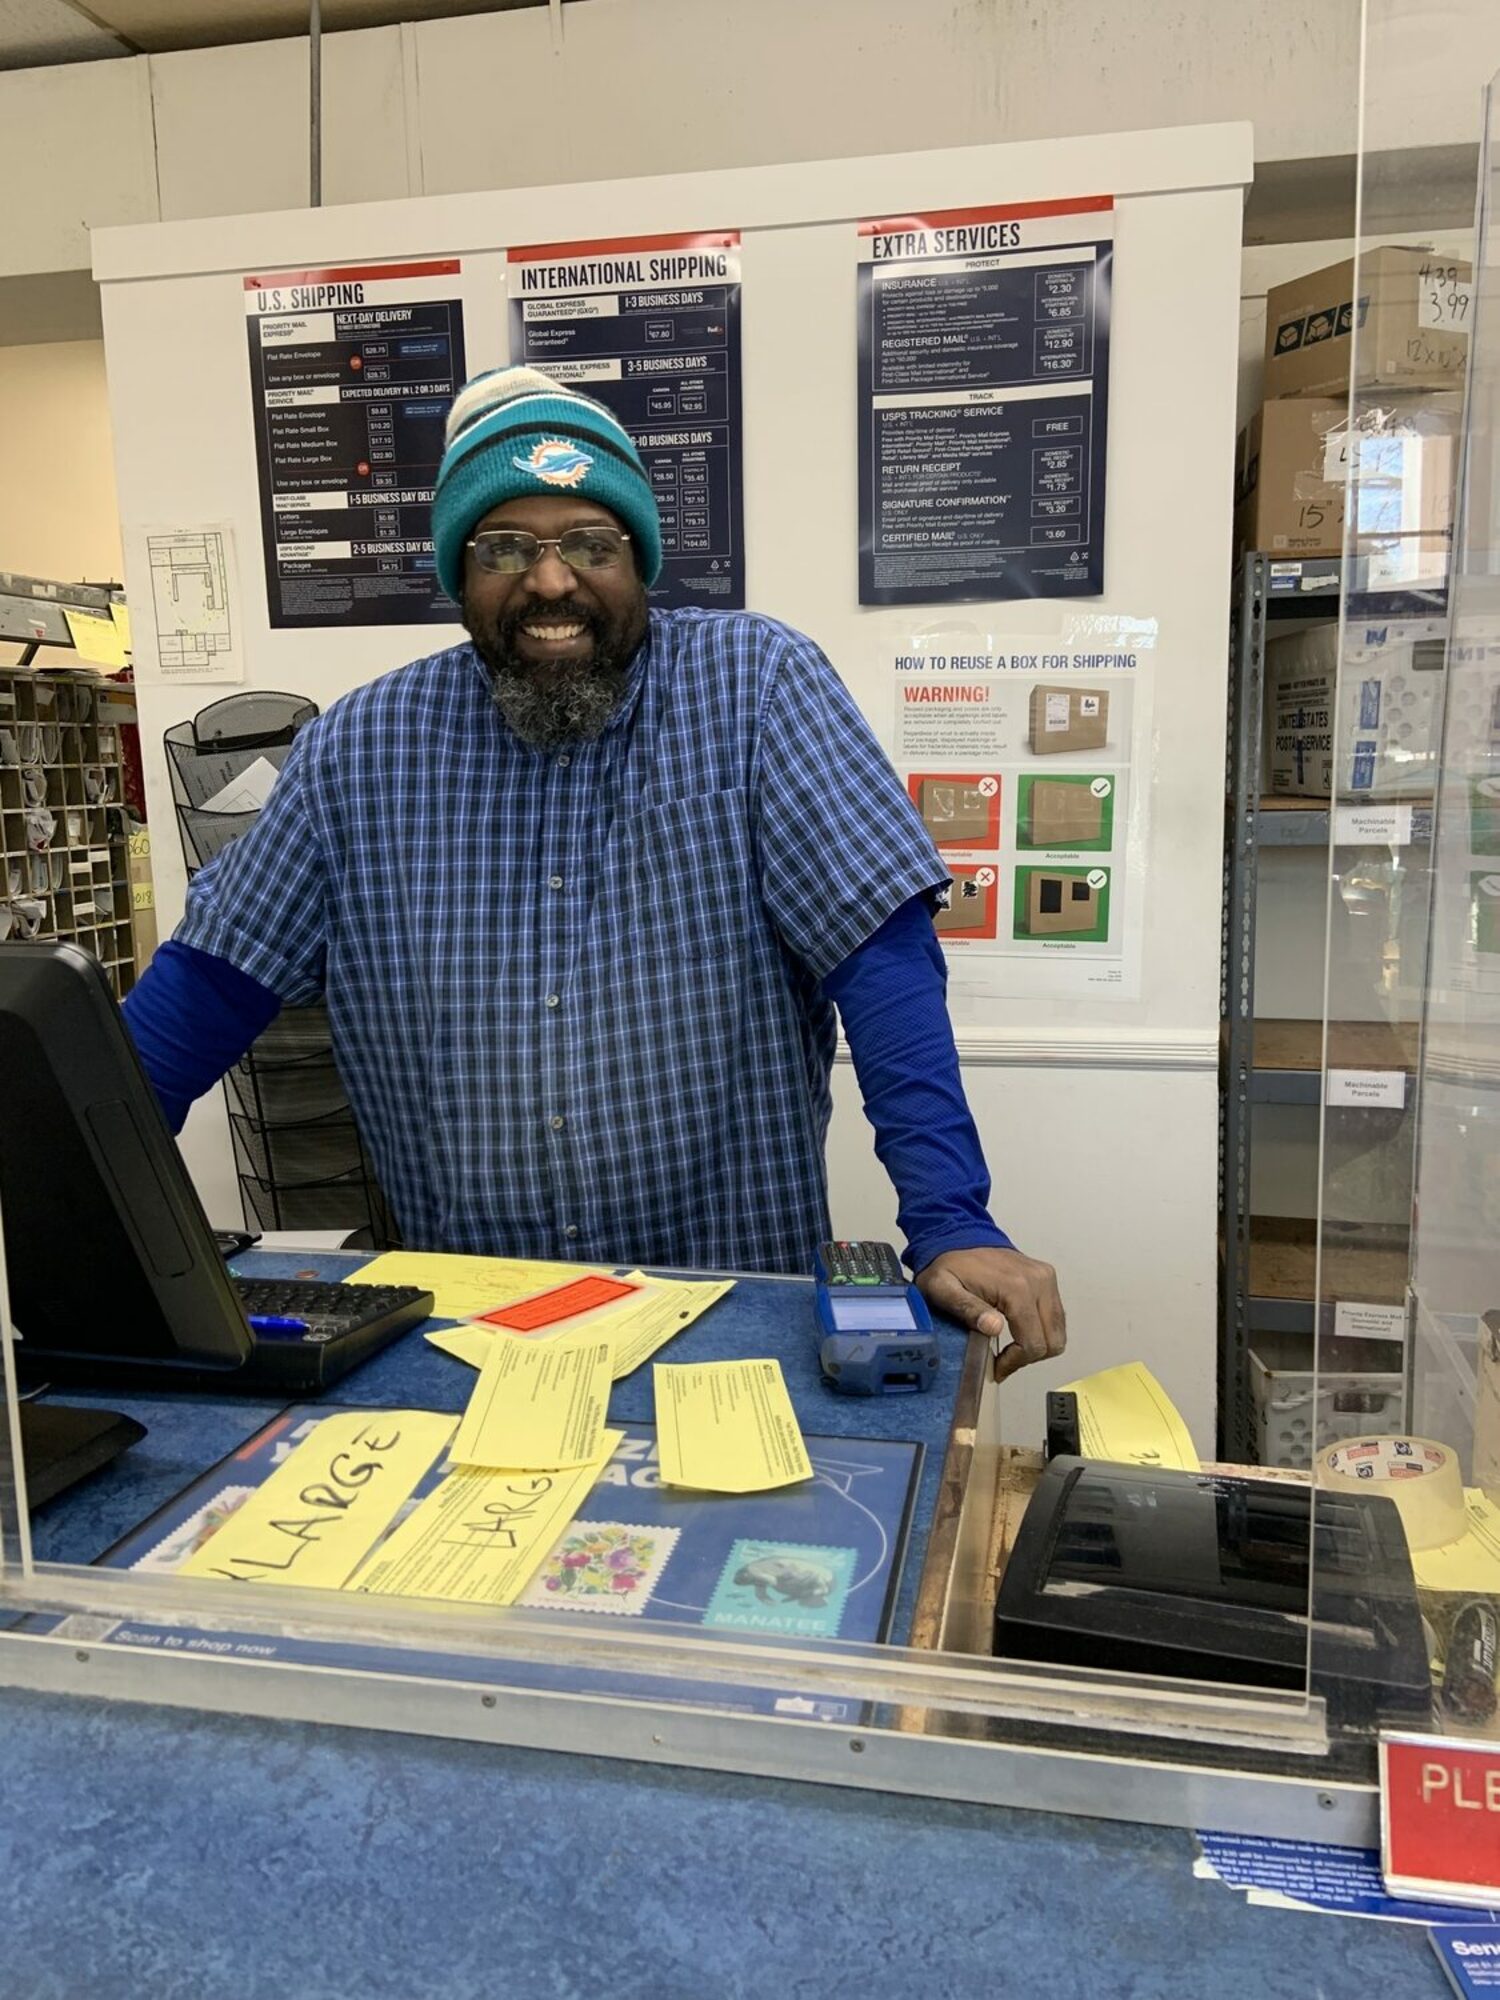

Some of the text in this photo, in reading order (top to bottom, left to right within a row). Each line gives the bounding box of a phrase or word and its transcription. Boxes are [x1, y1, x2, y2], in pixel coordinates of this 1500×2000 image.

[872, 222, 1021, 259] EXTRA SERVICES
[965, 259, 1000, 269] PROTECT
[521, 254, 727, 290] INTERNATIONAL SHIPPING
[882, 278, 937, 291] INSURANCE
[1048, 283, 1072, 294] $2.30
[257, 283, 364, 312] U.S. SHIPPING
[625, 291, 704, 308] 1-3 BUSINESS DAYS
[527, 300, 586, 310] GLOBAL EXPRESS
[336, 309, 413, 325] NEXT-DAY DELIVERY
[528, 328, 576, 338] Global Express
[881, 336, 941, 349] REGISTERED
[294, 351, 322, 359] Envelope
[580, 362, 610, 370] EXPRESS
[627, 355, 708, 372] 3-5 BUSINESS DAYS
[268, 375, 280, 383] Use
[281, 374, 293, 383] any
[293, 373, 305, 381] box
[313, 371, 340, 379] envelope
[267, 390, 296, 398] PRIORITY
[341, 388, 372, 399] EXPECTED
[373, 387, 401, 398] DELIVERY
[434, 383, 450, 392] DAYS
[283, 412, 298, 420] Rate
[298, 411, 326, 419] Envelope
[882, 411, 907, 421] USPS
[963, 406, 1004, 417] SERVICE
[1046, 422, 1069, 432] FREE
[286, 441, 300, 449] Rate
[300, 440, 325, 448] Medium
[326, 439, 338, 447] Box
[649, 433, 690, 446] BUSINESS
[691, 431, 712, 443] DAYS
[287, 456, 301, 464] Rate
[302, 455, 319, 464] Large
[882, 462, 961, 475] RETURN RECEIPT
[289, 479, 300, 487] any
[321, 477, 348, 485] envelope
[362, 492, 400, 504] BUSINESS
[401, 491, 417, 502] DAY
[882, 499, 934, 510] SIGNATURE
[280, 529, 297, 537] Large
[882, 532, 930, 543] CERTIFIED
[353, 541, 421, 554] 2-5 BUSINESS DAY
[283, 562, 311, 570] Packages
[895, 654, 1137, 670] HOW TO REUSE A BOX FOR SHIPPING
[904, 686, 989, 703] WARNING!
[1351, 817, 1396, 825] Machinable
[1358, 826, 1388, 834] Parcels
[1344, 1080, 1388, 1090] Machinable
[1351, 1090, 1380, 1098] Parcels
[441, 1468, 560, 1549] LARG
[714, 1611, 827, 1632] MANATEE
[115, 1630, 277, 1655] Scan to shop now
